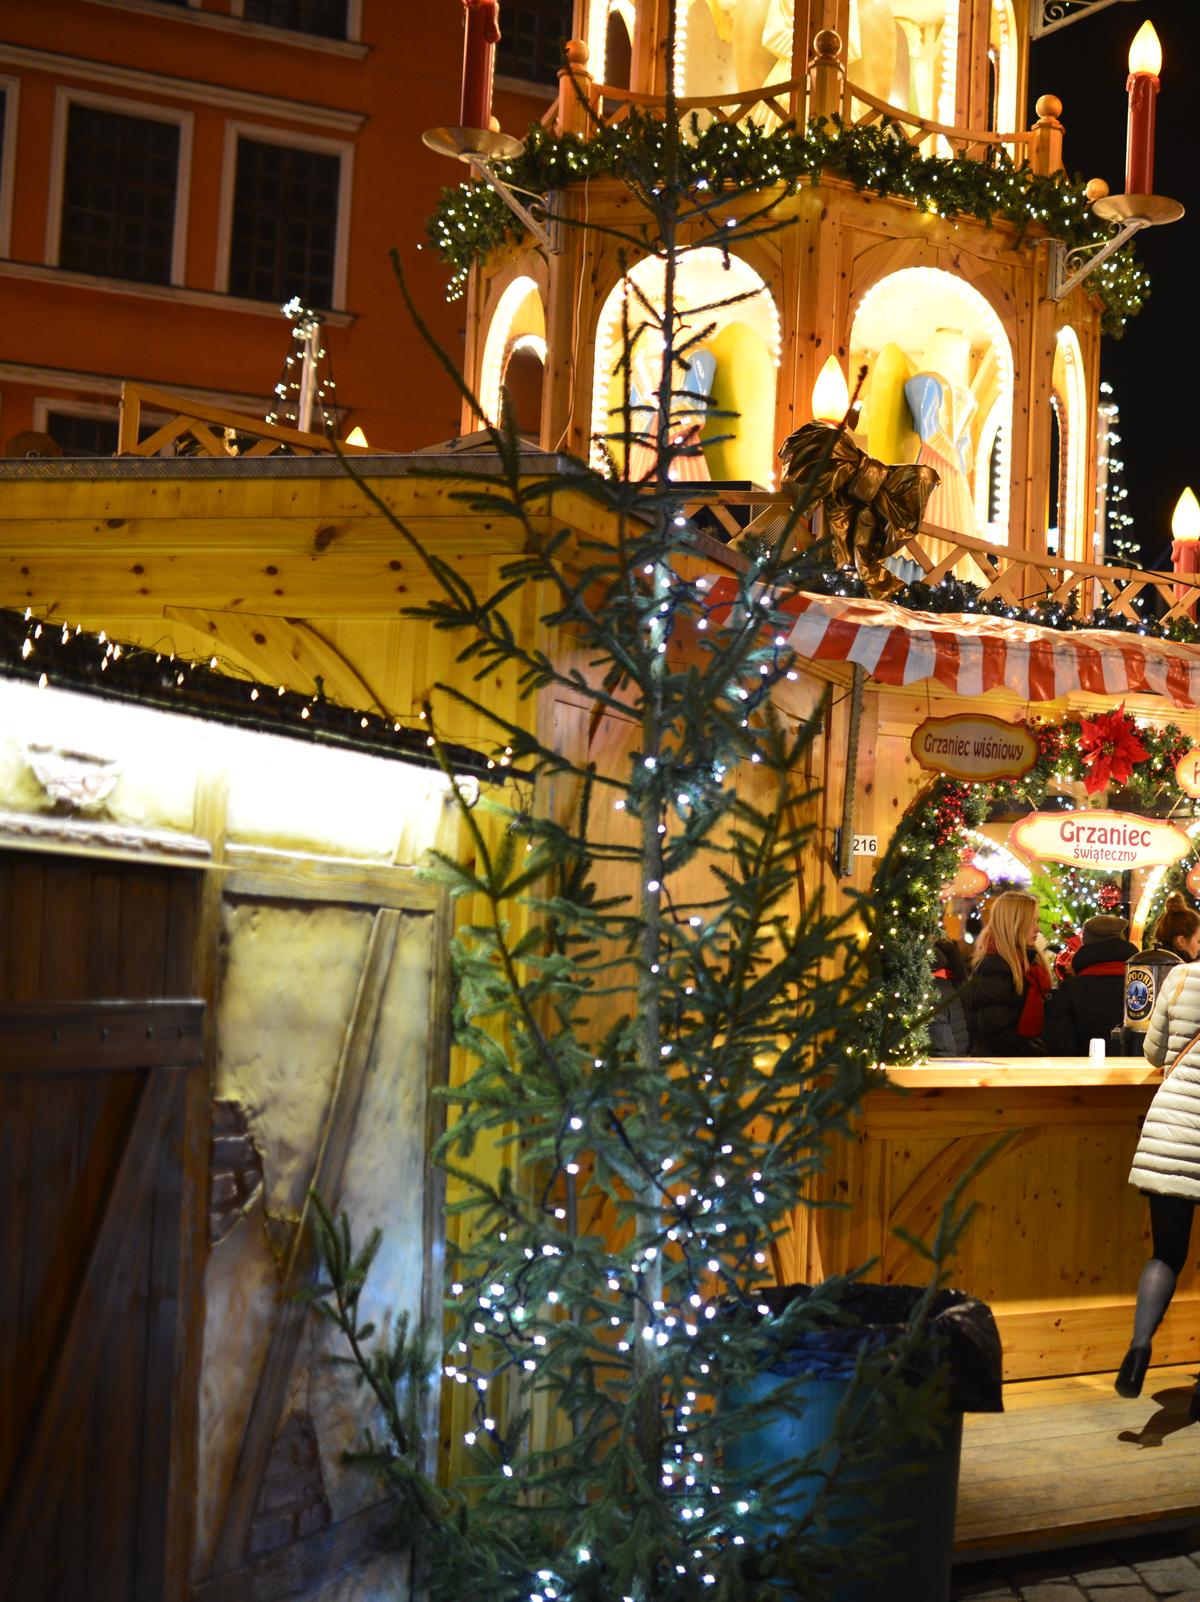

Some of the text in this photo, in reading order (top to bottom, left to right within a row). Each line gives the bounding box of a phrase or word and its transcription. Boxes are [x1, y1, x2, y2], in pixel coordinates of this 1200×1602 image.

[924, 733, 1024, 761] Grzaniec wiśniowy
[853, 838, 877, 852] 216
[1059, 820, 1151, 847] Grzaniec
[1073, 844, 1137, 864] świąteczny
